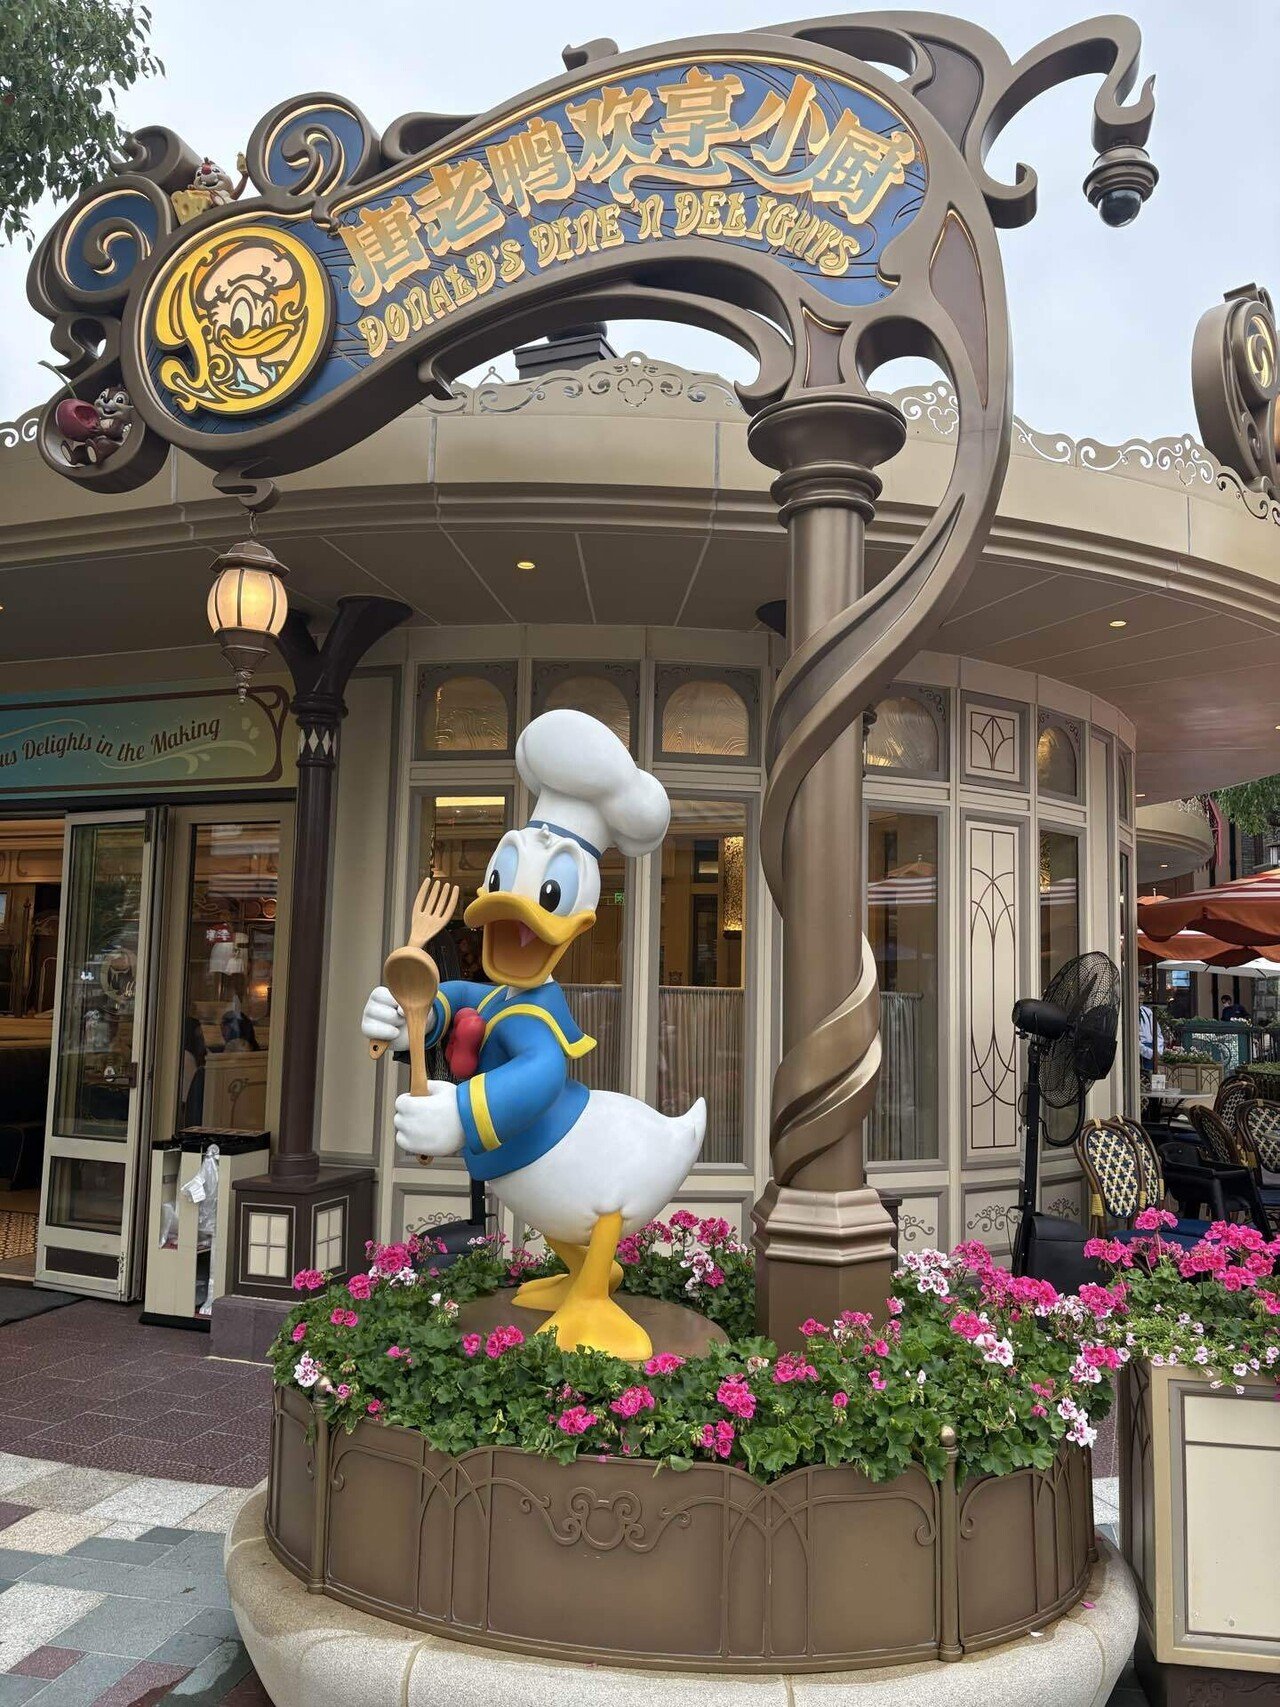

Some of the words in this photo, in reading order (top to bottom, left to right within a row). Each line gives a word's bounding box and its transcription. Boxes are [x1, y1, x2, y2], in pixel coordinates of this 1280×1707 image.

[338, 66, 915, 306] 唐老鸭欢享小厨
[358, 238, 524, 357] DONALD'S
[529, 204, 627, 267] DINE
[674, 190, 861, 275] DELIGHTS
[22, 732, 92, 758] Delights
[96, 735, 113, 757] in
[117, 743, 145, 761] the
[151, 719, 221, 755] Making
